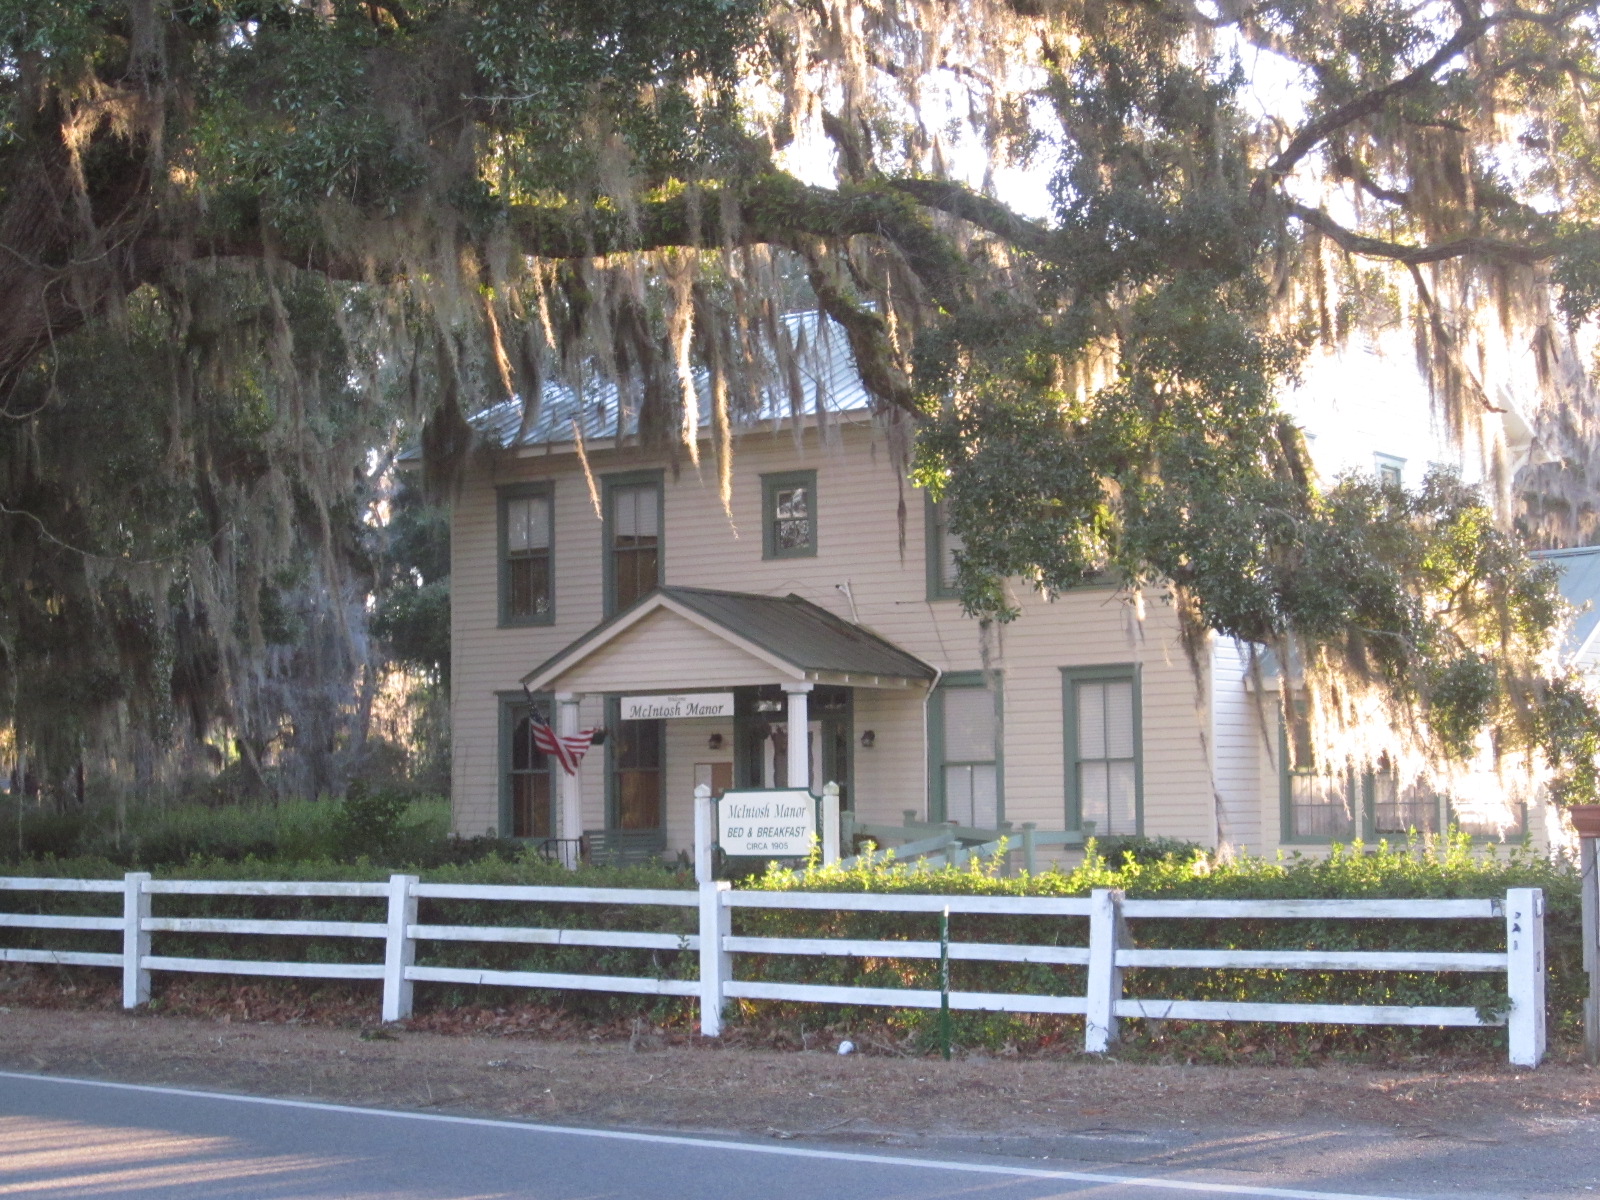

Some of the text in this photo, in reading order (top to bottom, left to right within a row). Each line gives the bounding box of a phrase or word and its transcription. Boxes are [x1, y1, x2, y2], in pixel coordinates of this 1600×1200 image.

[630, 702, 724, 718] McIntosh Manor
[728, 803, 806, 818] McIntosh Manor
[728, 827, 806, 838] BED & BREAKFAST
[746, 842, 789, 850] CIRCA 1905
